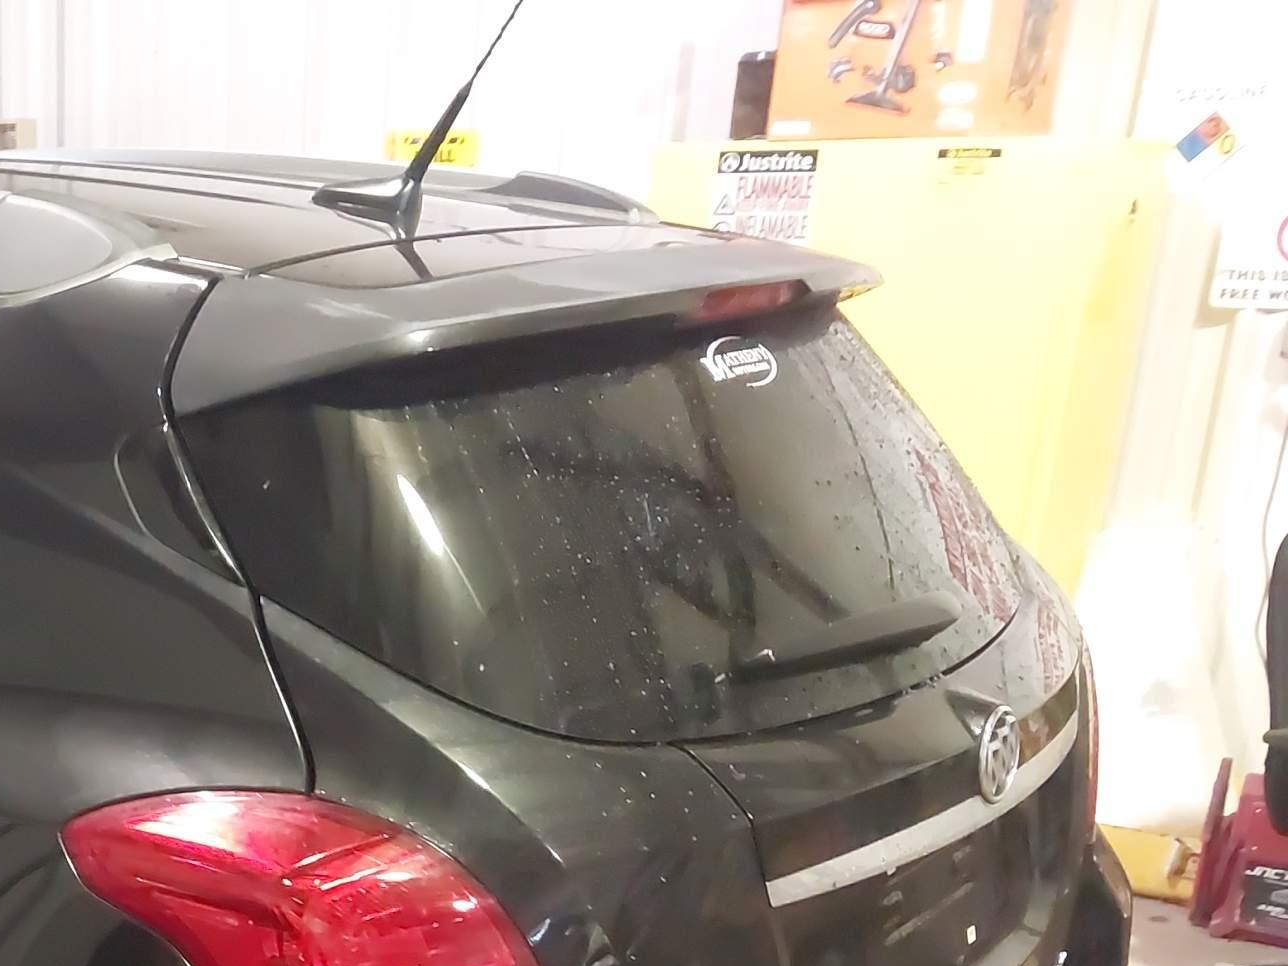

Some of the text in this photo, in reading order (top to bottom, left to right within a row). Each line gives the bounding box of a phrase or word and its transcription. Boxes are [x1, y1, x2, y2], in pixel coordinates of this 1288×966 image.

[738, 151, 815, 172] Justrite
[736, 175, 814, 200] FLAMMABLE
[1219, 287, 1260, 300] FREE
